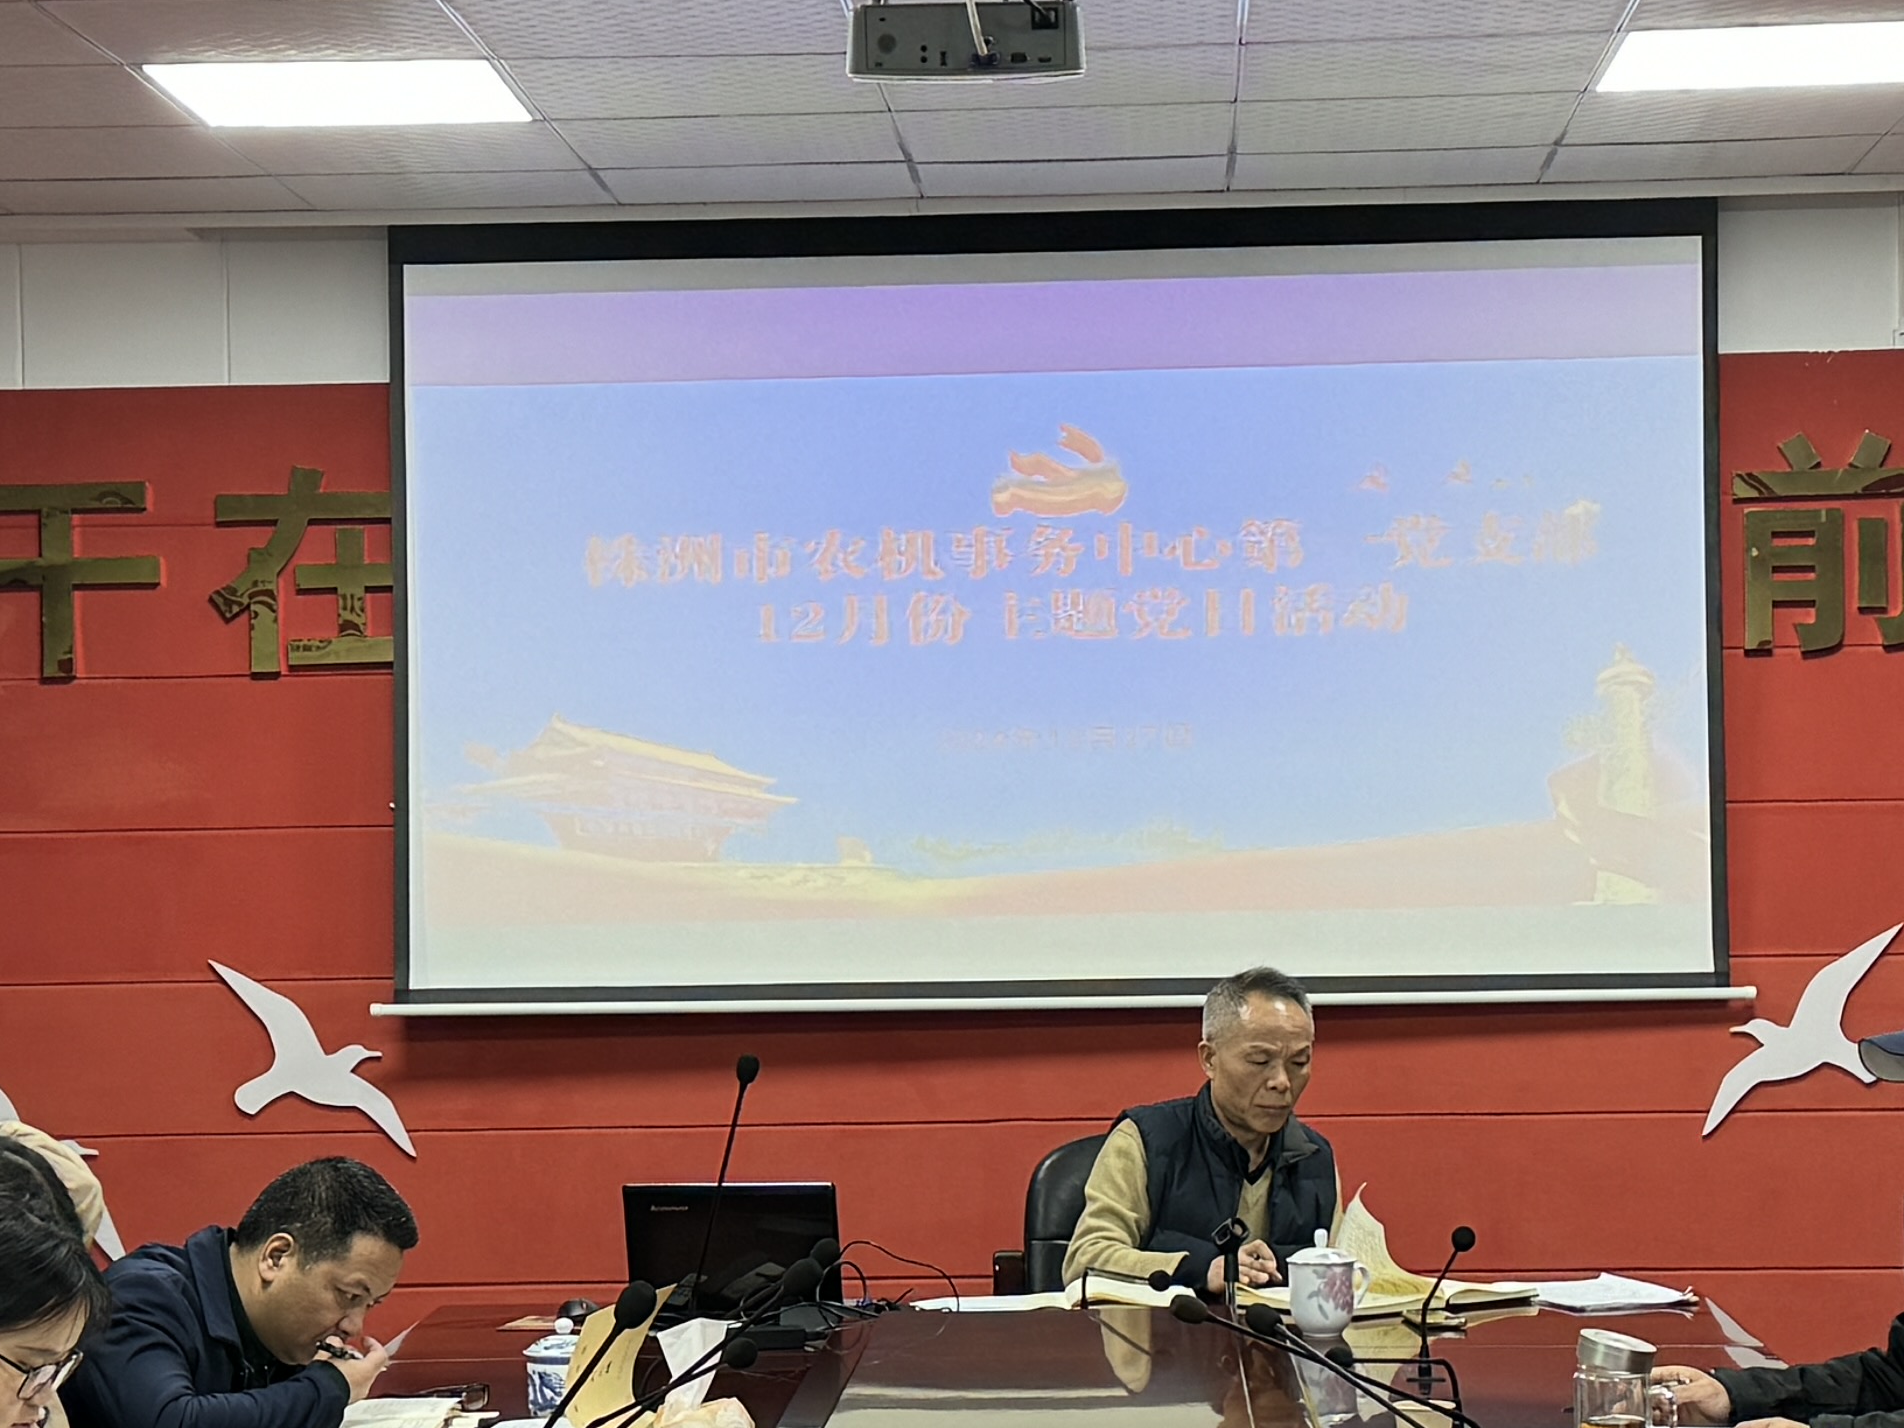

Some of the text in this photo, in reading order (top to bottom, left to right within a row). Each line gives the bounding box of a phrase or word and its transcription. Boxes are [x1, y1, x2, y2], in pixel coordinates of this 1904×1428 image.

[757, 580, 1409, 646] 12月份主题党日活动
